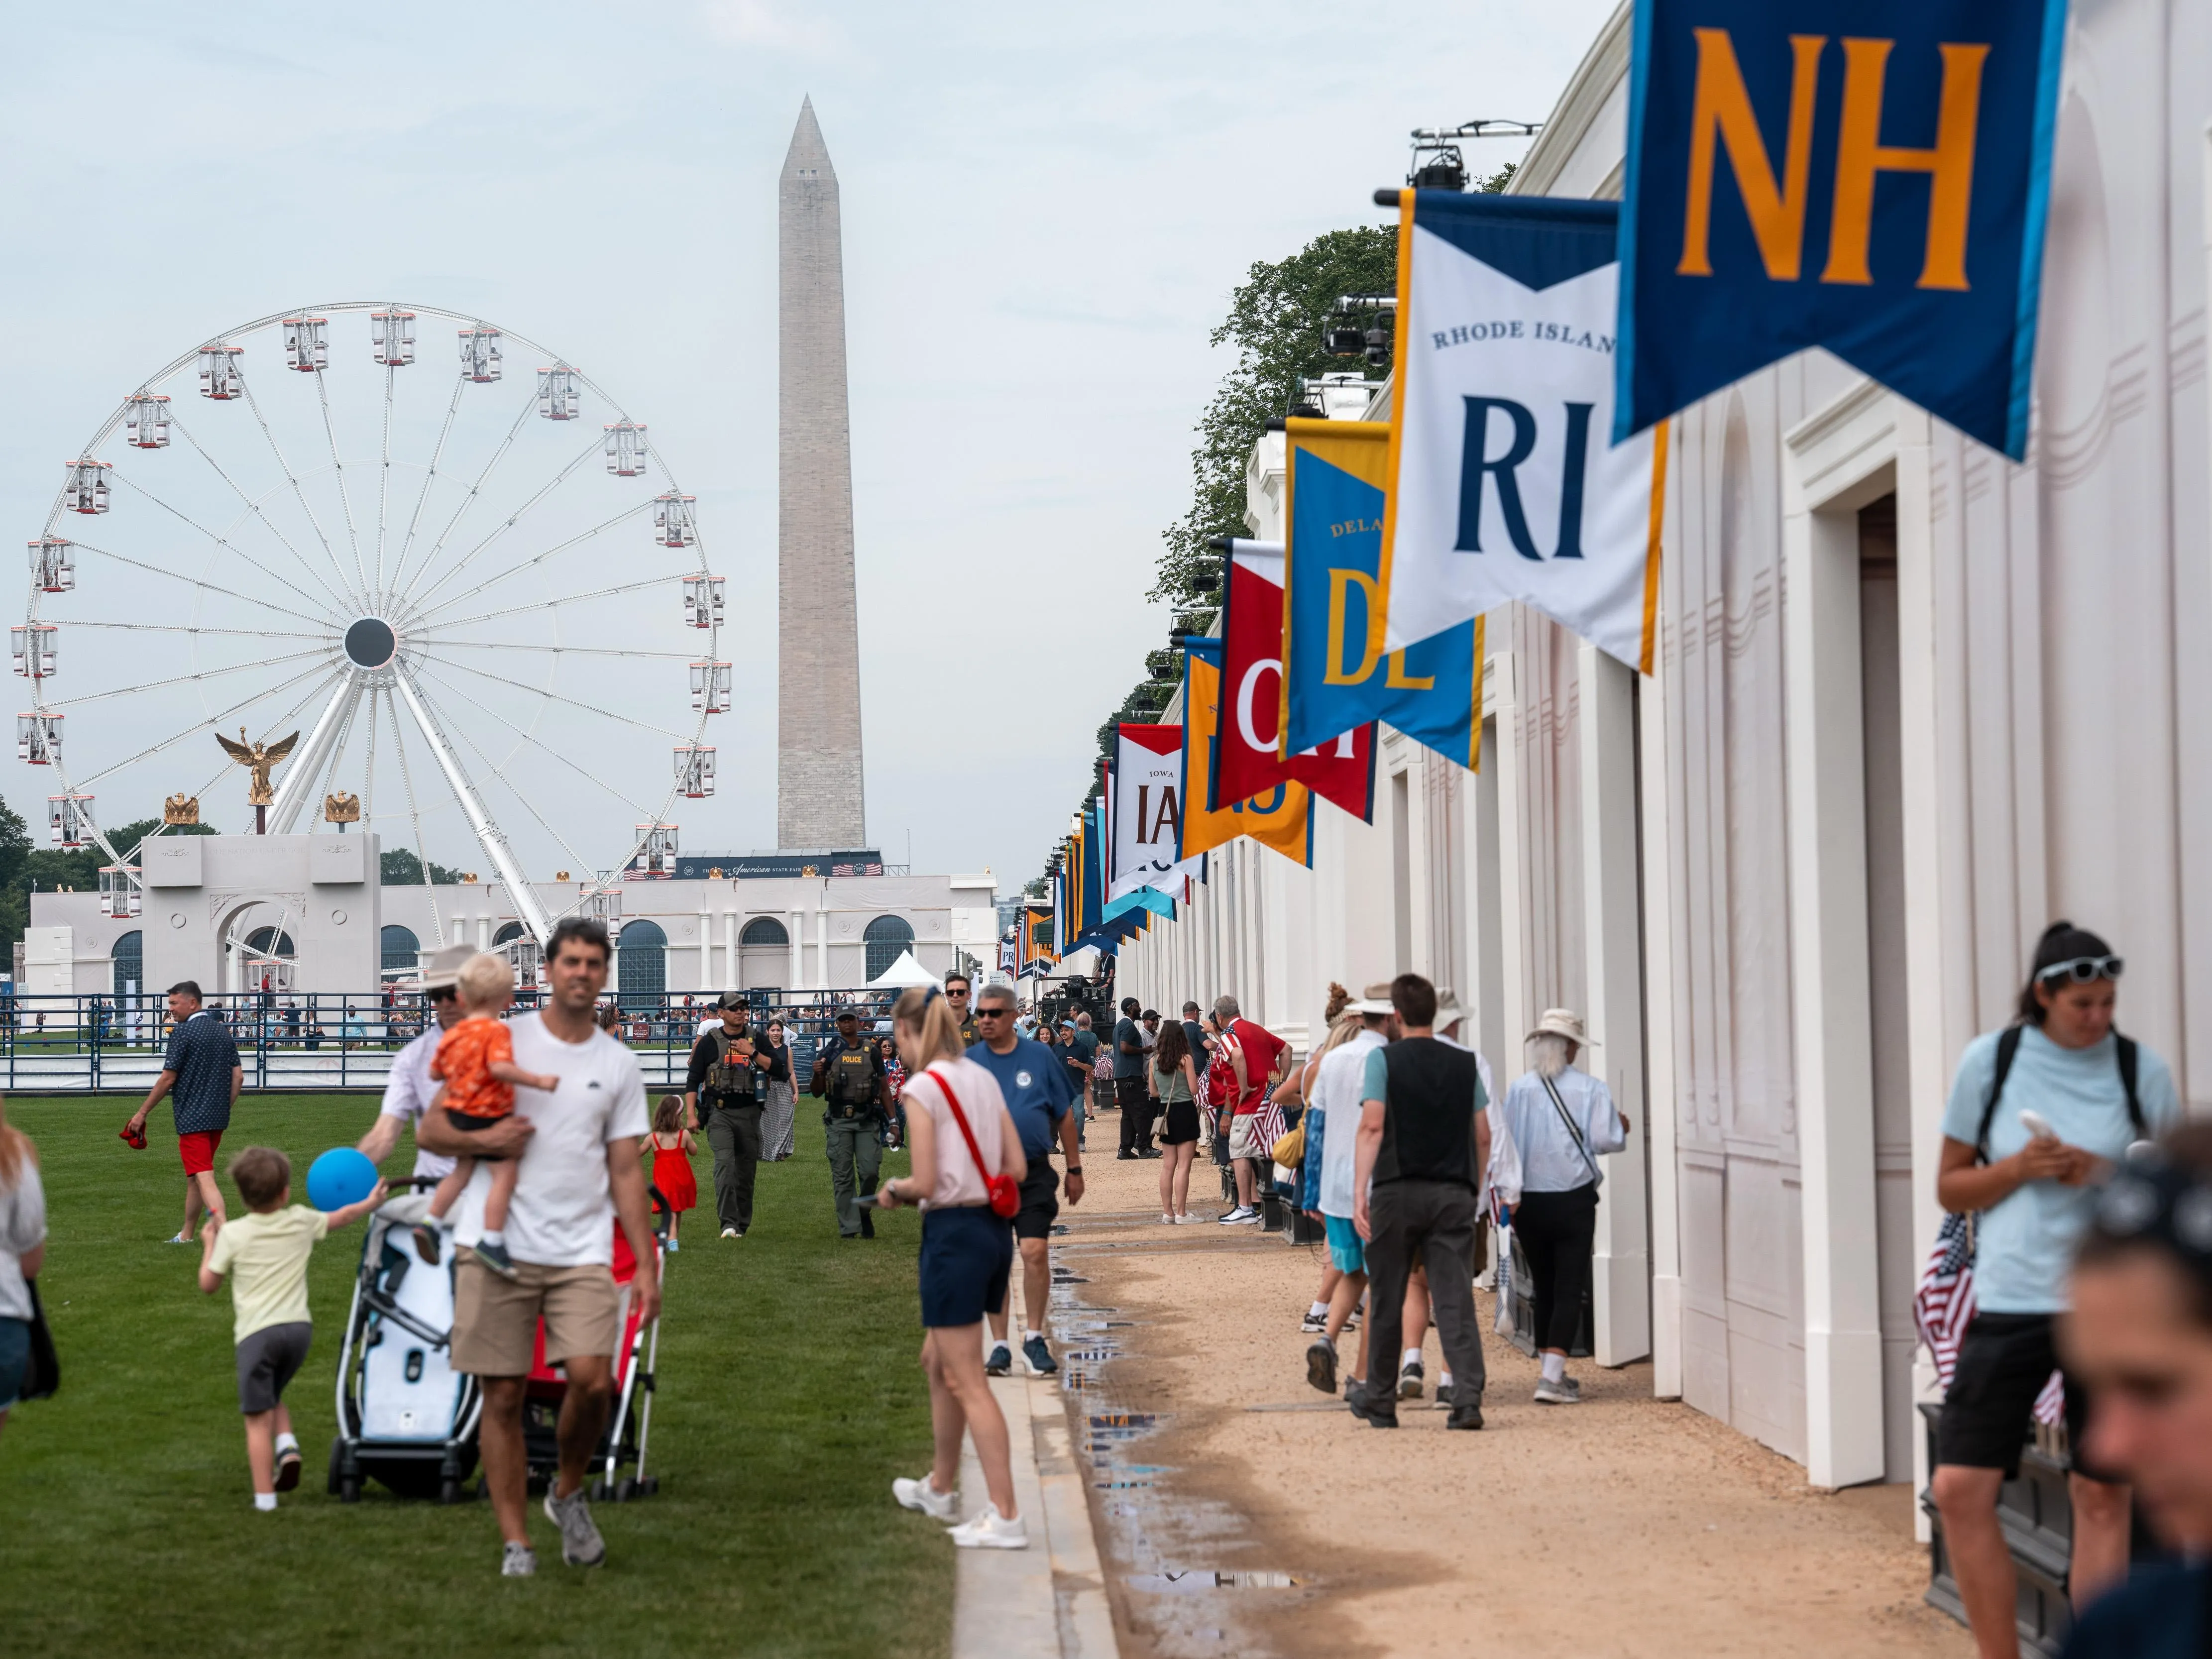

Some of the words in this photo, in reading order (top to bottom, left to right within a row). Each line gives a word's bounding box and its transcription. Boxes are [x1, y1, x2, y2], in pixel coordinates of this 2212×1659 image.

[1676, 27, 1991, 291] NH
[1432, 320, 1524, 350] RHODE
[1535, 322, 1617, 354] ISLAN
[1453, 395, 1596, 562] RI
[1329, 518, 1383, 538] DELA
[1136, 785, 1179, 845] IA
[728, 863, 771, 876] American
[1003, 951, 1014, 962] PR
